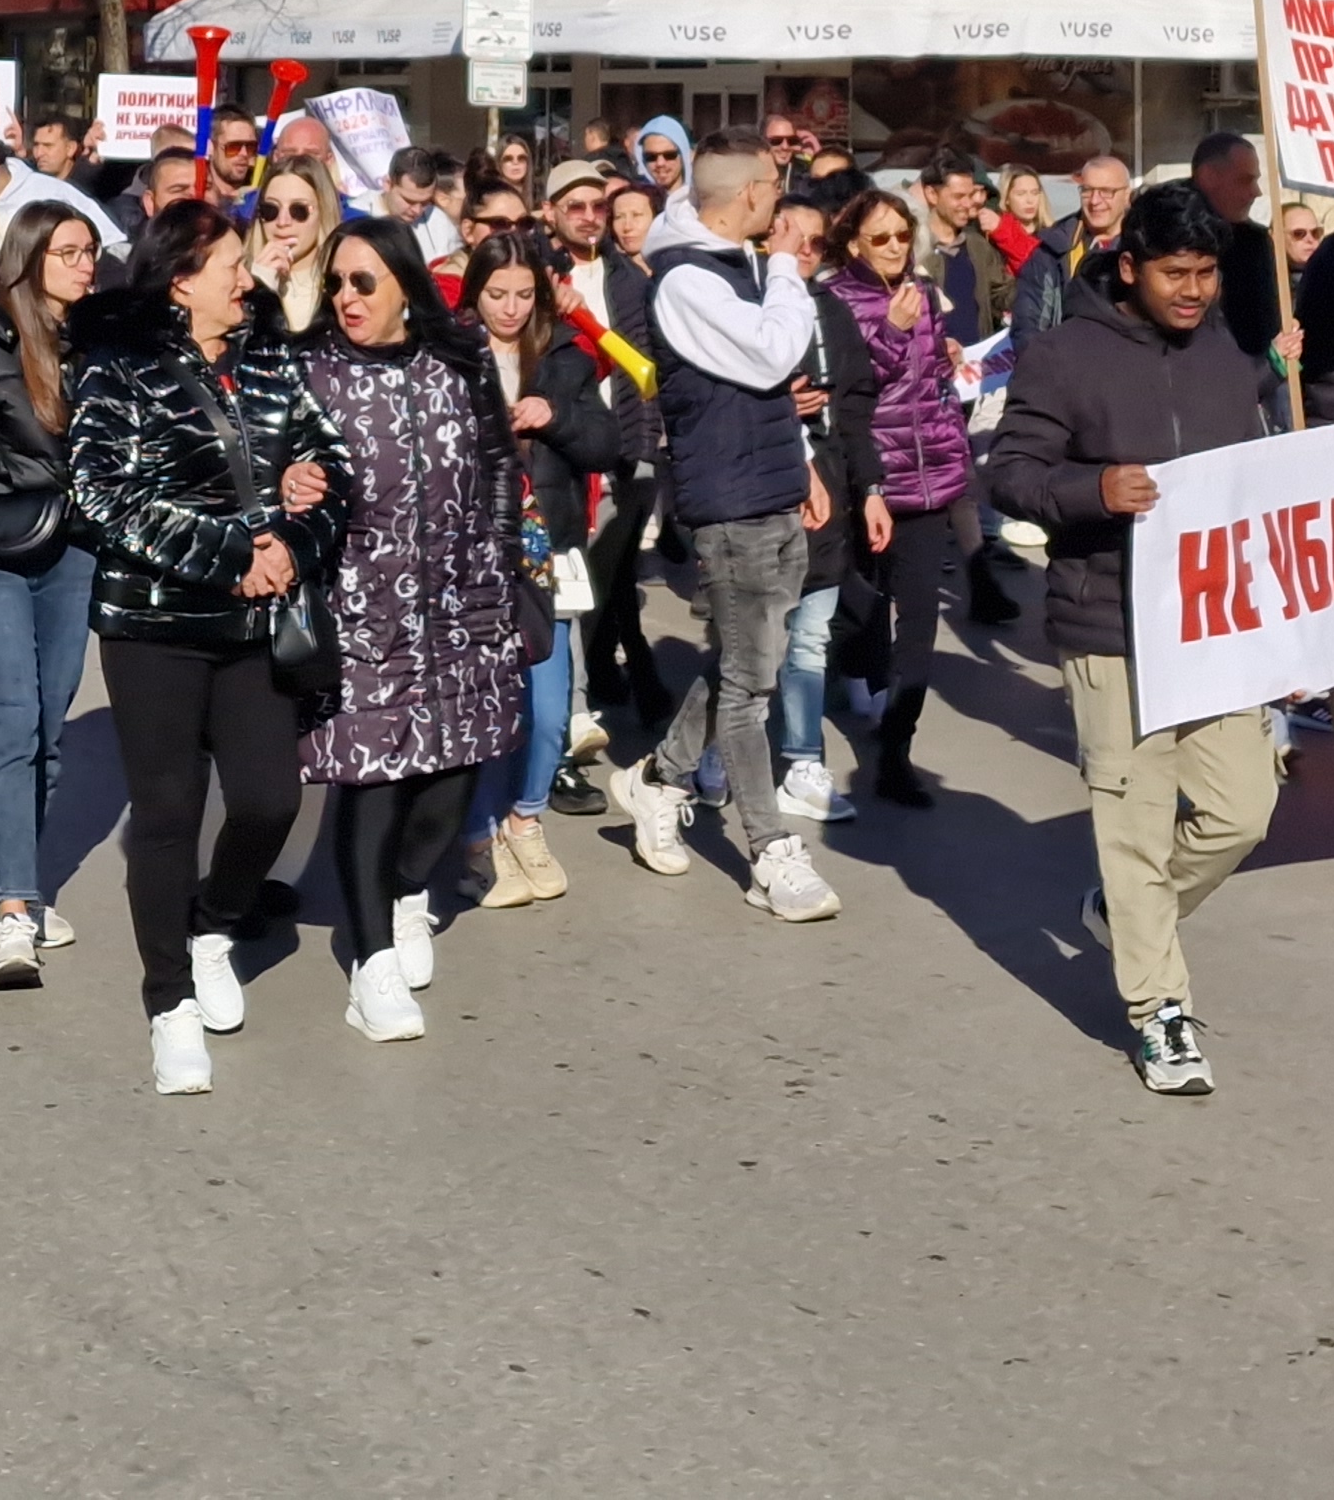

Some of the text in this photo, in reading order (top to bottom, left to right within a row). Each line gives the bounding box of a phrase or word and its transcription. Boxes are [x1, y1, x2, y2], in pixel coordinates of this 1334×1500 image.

[115, 112, 132, 125] НЕ
[1285, 82, 1331, 137] ДА
[1178, 518, 1263, 643] НЕ
